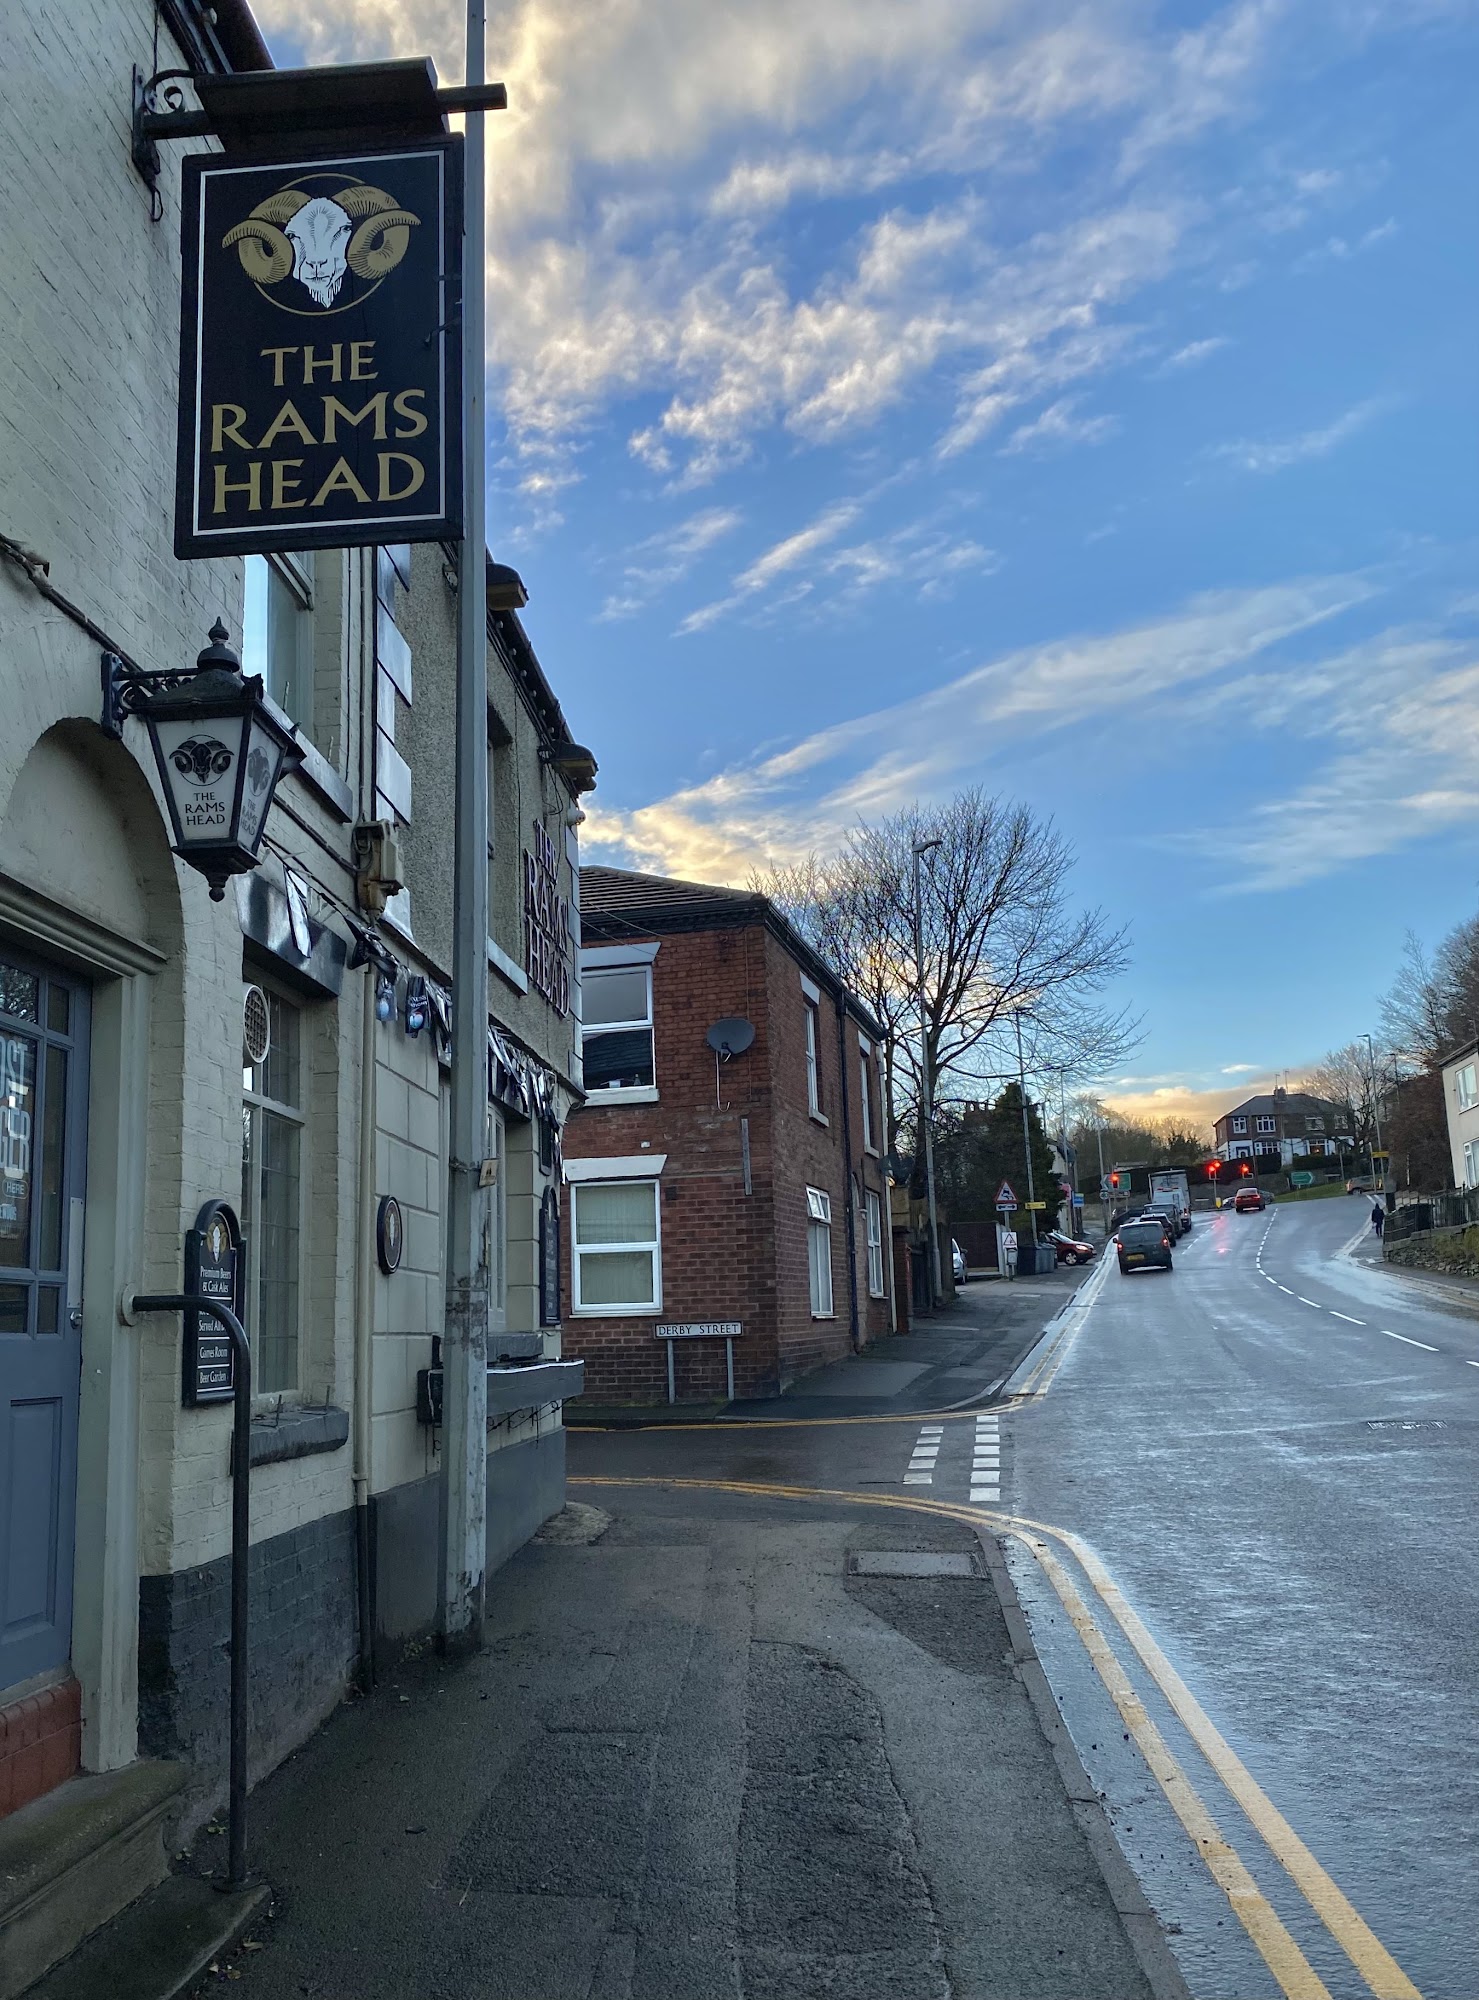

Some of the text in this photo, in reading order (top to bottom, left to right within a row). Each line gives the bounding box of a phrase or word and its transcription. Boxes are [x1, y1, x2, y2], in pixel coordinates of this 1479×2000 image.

[260, 340, 378, 386] THE
[210, 389, 428, 452] RAMS
[212, 452, 425, 514] HEAD
[193, 792, 215, 801] THE
[185, 802, 225, 813] RAMS
[186, 814, 225, 825] HEAD
[241, 817, 255, 835] HEAD
[535, 820, 557, 883] THE
[526, 914, 570, 1018] HEAD
[7, 1182, 25, 1195] HERE
[200, 1265, 231, 1279] Premium Beers
[208, 1281, 218, 1291] Cask
[219, 1282, 228, 1292] Ales
[199, 1320, 213, 1331] Served
[659, 1324, 739, 1335] DERBY STREET
[200, 1346, 227, 1358] Games Room
[200, 1371, 226, 1383] Beer Garden
